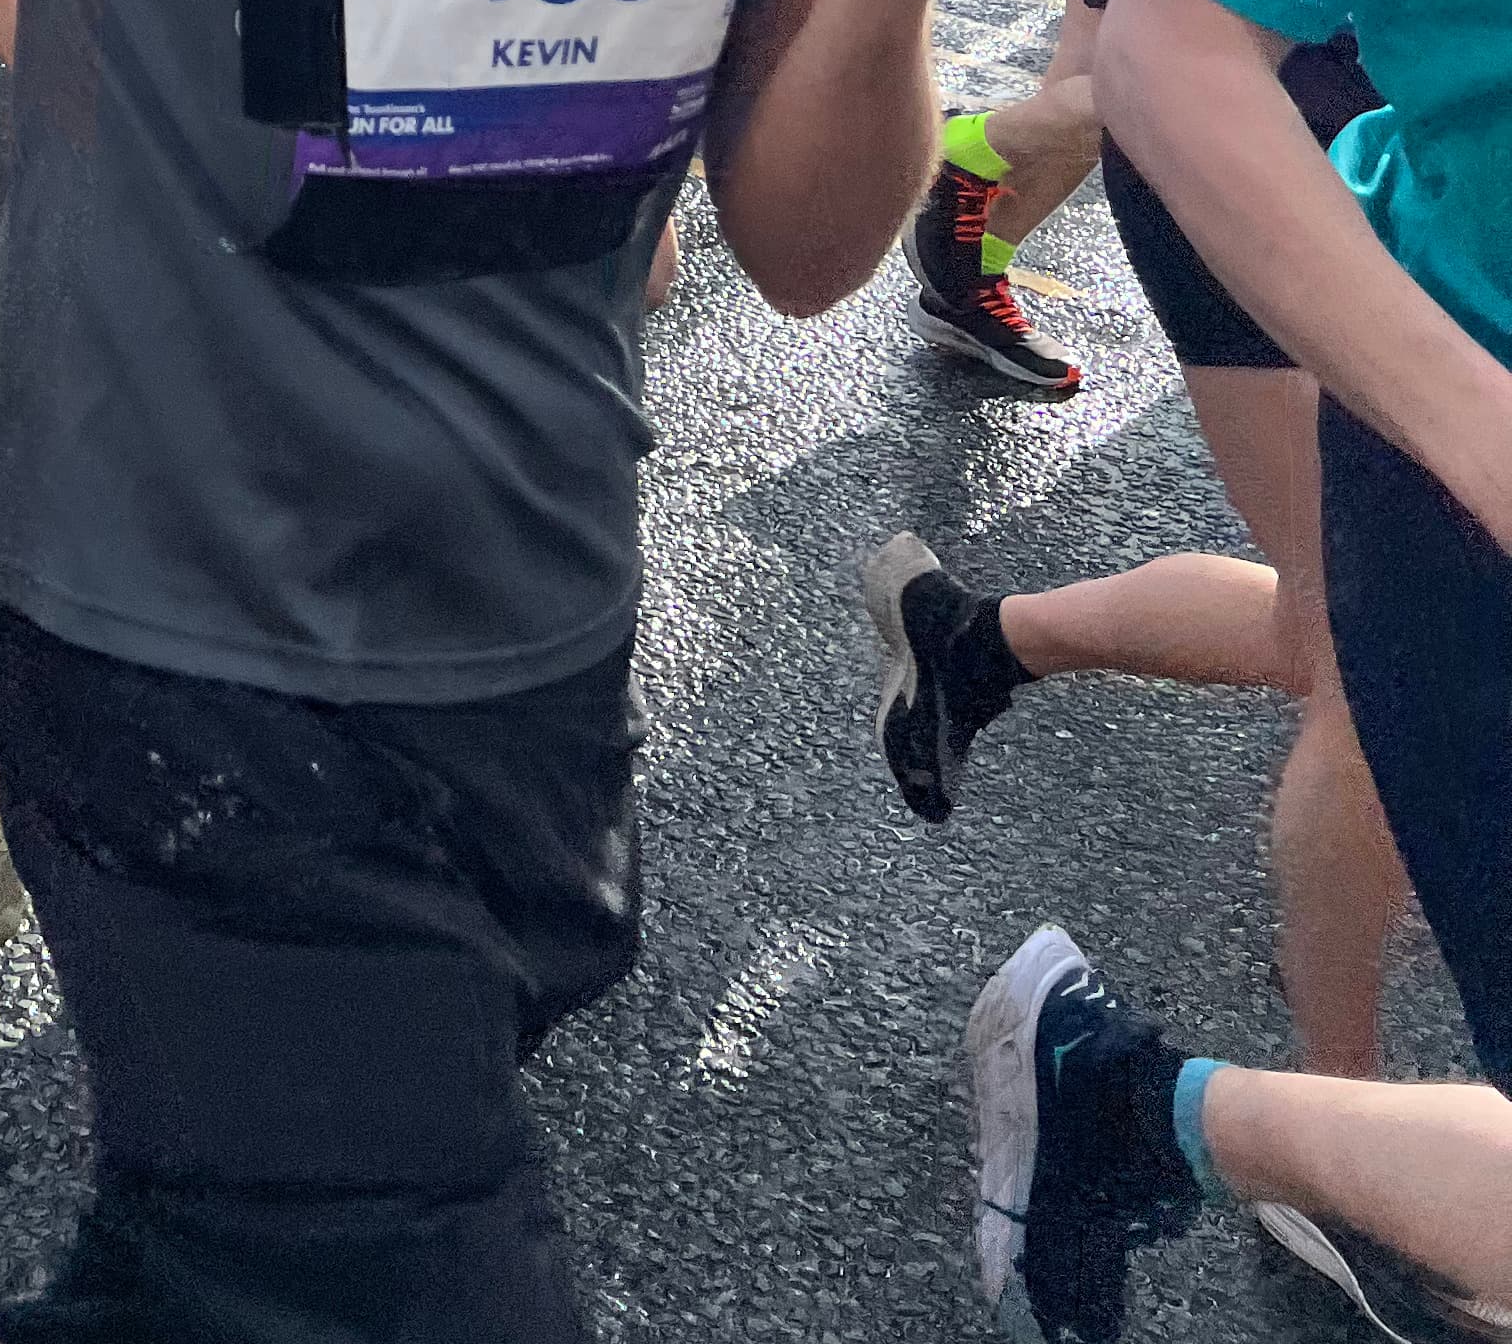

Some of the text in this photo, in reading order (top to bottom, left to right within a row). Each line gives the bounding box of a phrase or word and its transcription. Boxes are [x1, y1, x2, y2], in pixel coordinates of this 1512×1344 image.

[492, 36, 598, 68] KEVIN
[348, 115, 455, 135] UN FOR ALL
